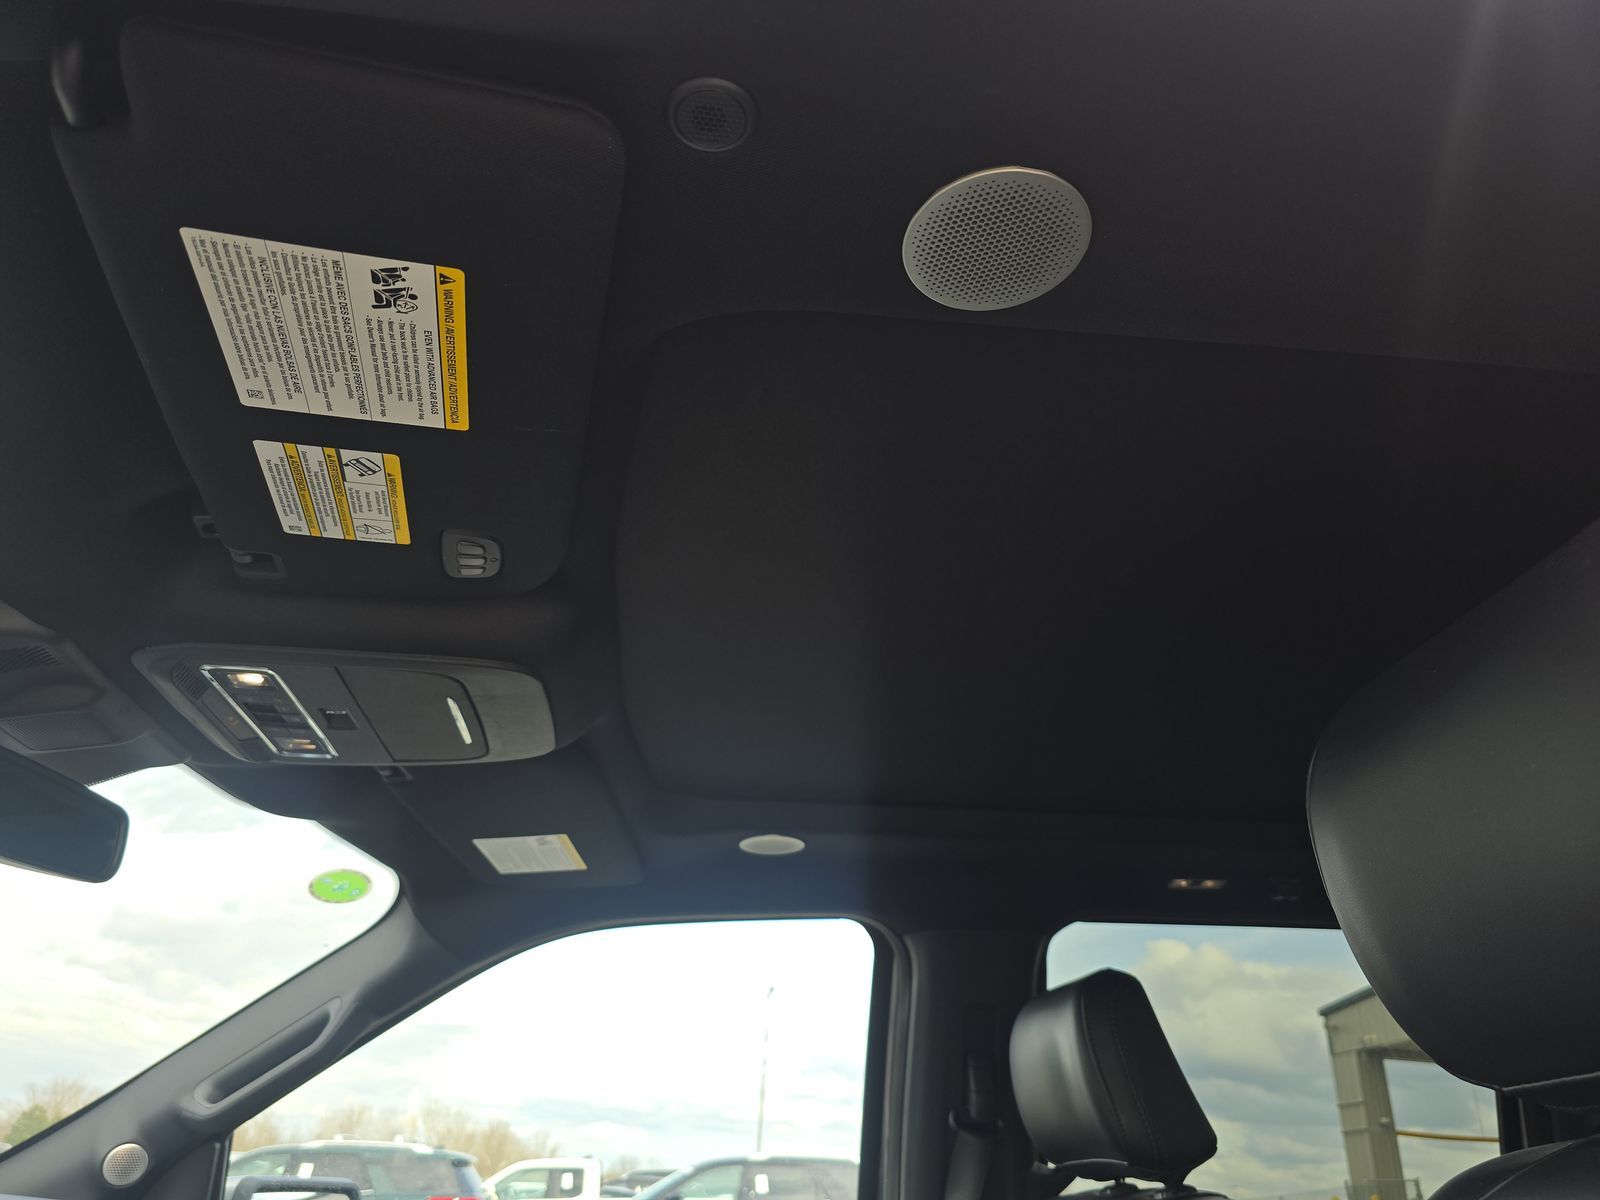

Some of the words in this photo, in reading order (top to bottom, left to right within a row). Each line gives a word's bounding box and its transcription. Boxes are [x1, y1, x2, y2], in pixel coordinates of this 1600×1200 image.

[258, 256, 276, 294] INCLUSIVE
[332, 260, 344, 281] MÊME
[336, 282, 347, 301] AVEC
[269, 296, 280, 310] CON
[340, 302, 350, 316] DES
[444, 288, 454, 324] WARNING
[273, 311, 284, 324] LAS
[343, 316, 353, 333] SACS
[277, 325, 290, 349] NUEVAS
[424, 330, 433, 346] EVEN
[284, 350, 296, 371] BOLSAS
[346, 335, 360, 372] GONFLABLES
[426, 348, 434, 362] WITH
[290, 373, 299, 381] DE
[427, 362, 437, 391] ADVANCED
[292, 381, 302, 394] AIRE
[353, 373, 369, 415] PERFECTIONNÉS
[431, 401, 439, 415] BAGS
